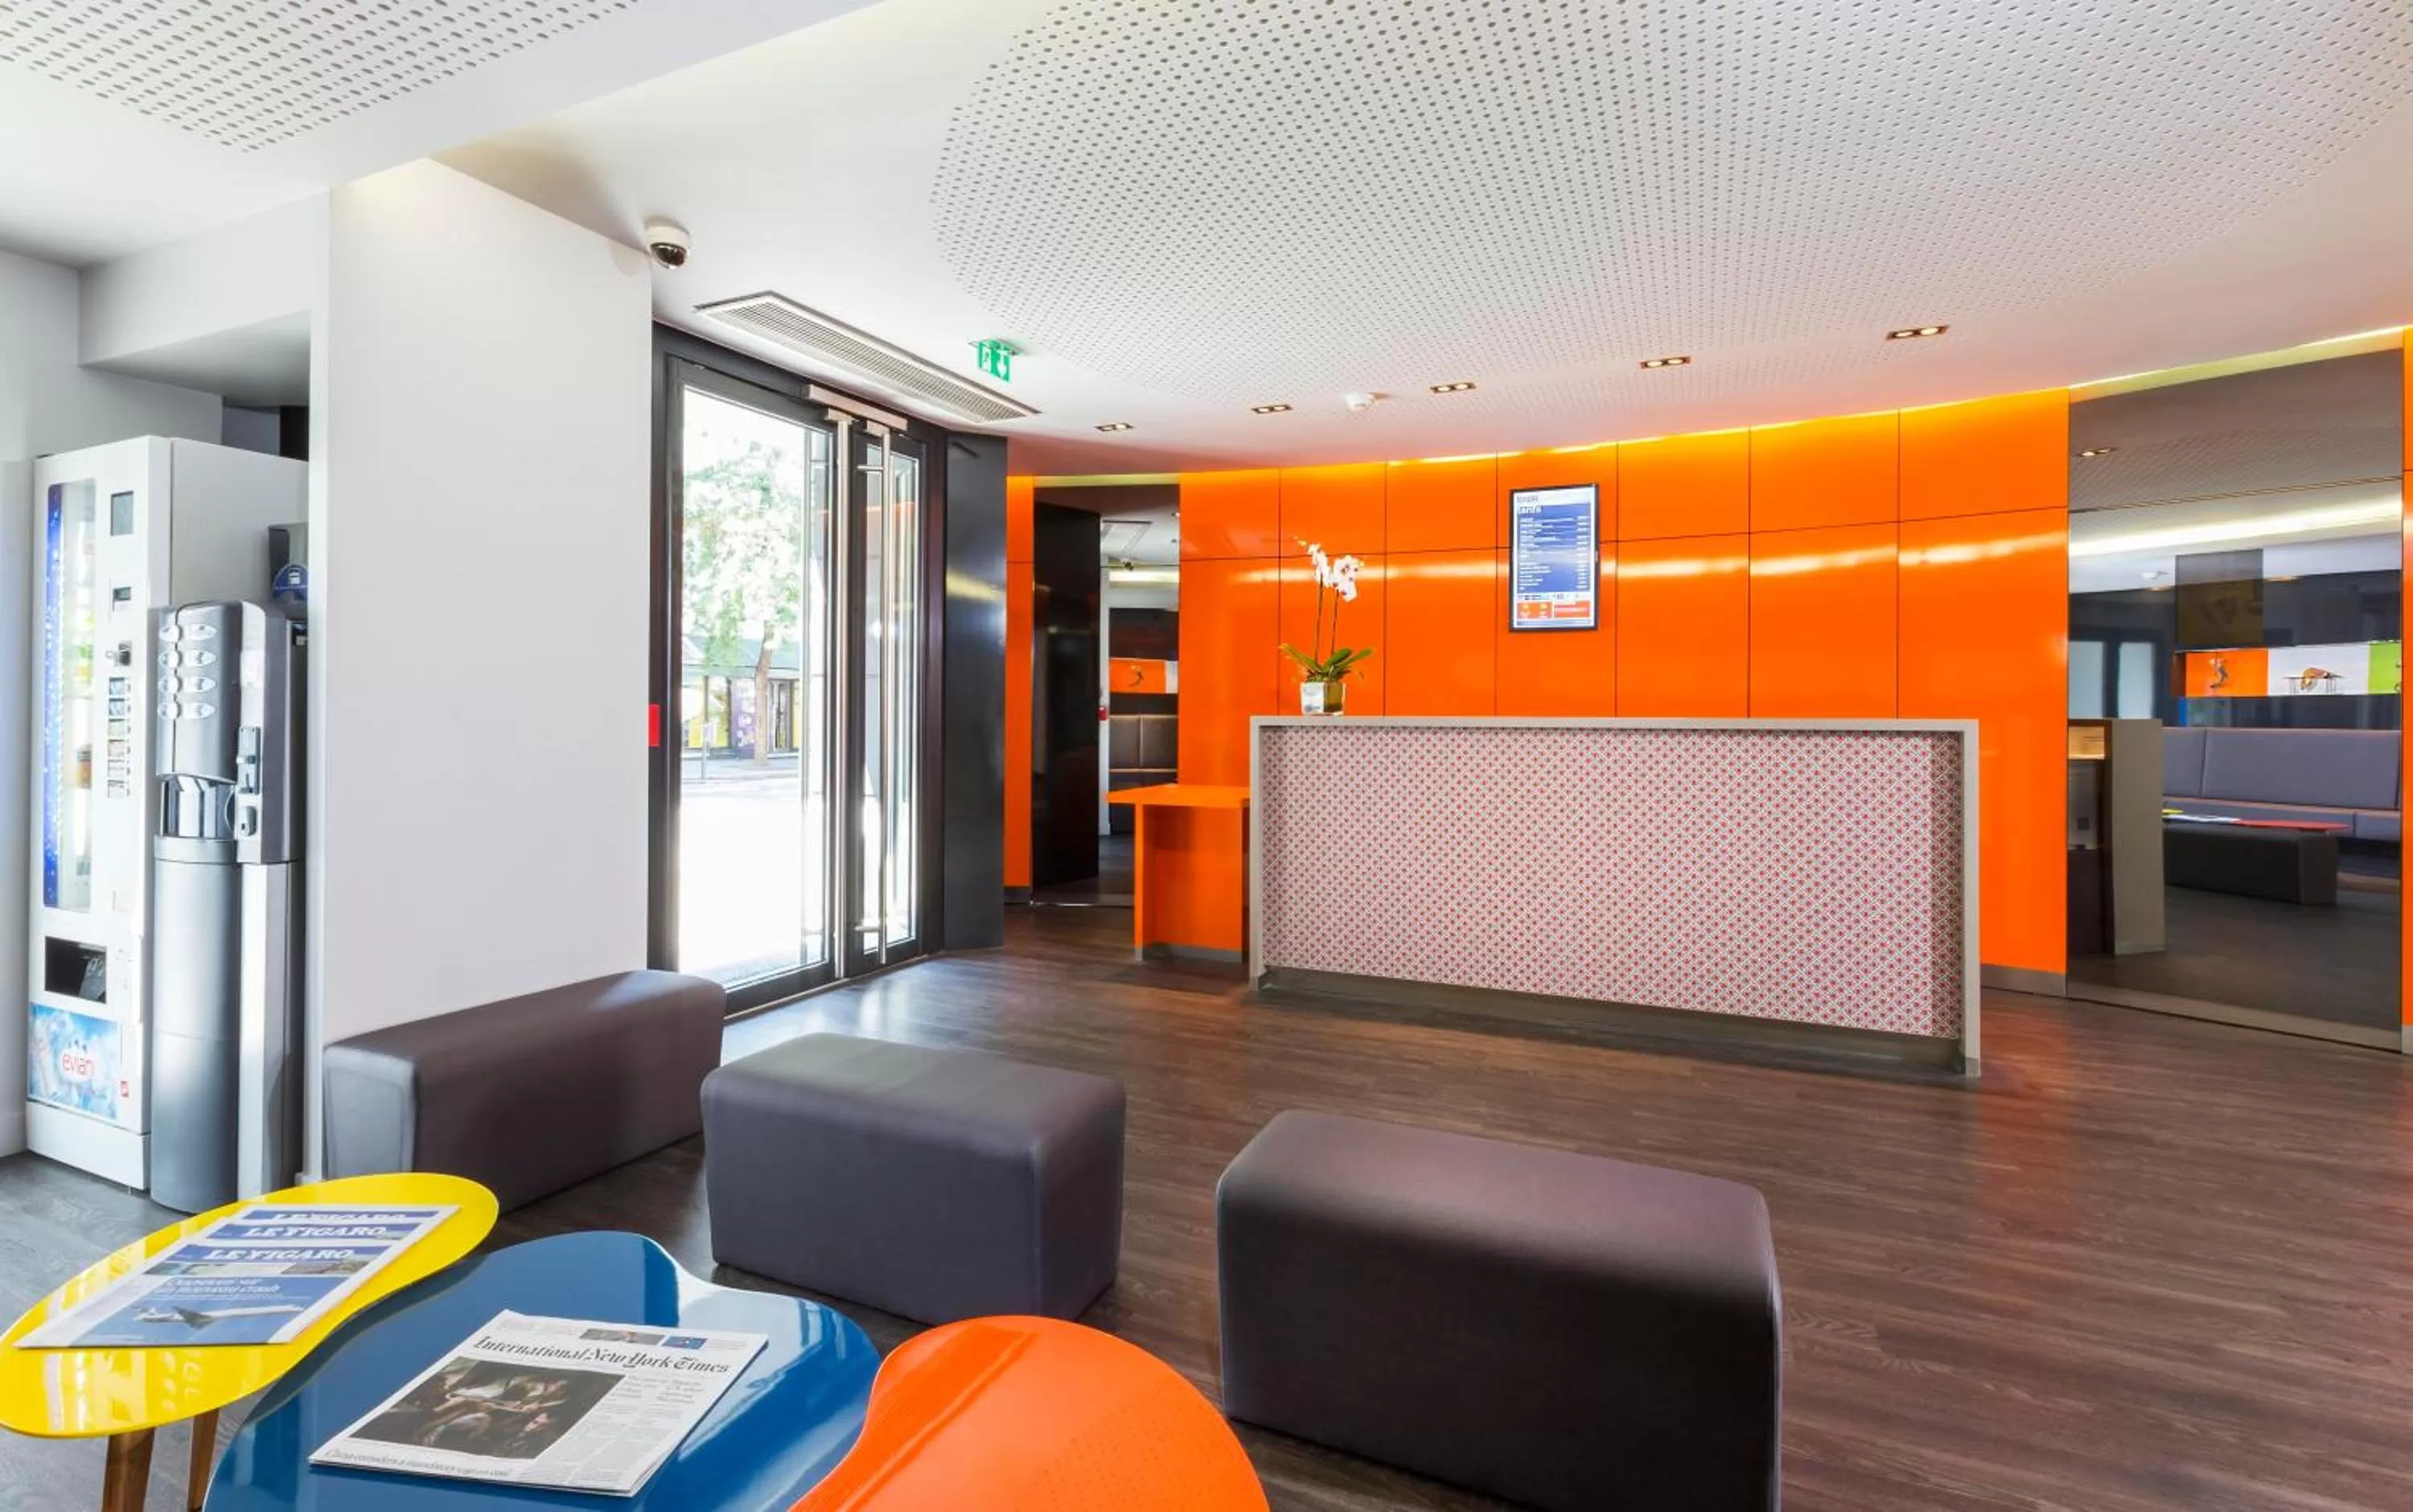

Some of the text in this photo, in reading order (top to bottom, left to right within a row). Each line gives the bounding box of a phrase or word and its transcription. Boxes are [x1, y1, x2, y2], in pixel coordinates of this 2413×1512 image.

[63, 1053, 93, 1076] evian
[244, 1226, 282, 1237] LE
[282, 1226, 387, 1237] FIGARO
[203, 1249, 245, 1260] LE
[245, 1248, 354, 1260] FIGARO
[473, 1335, 730, 1373] International New York Times
